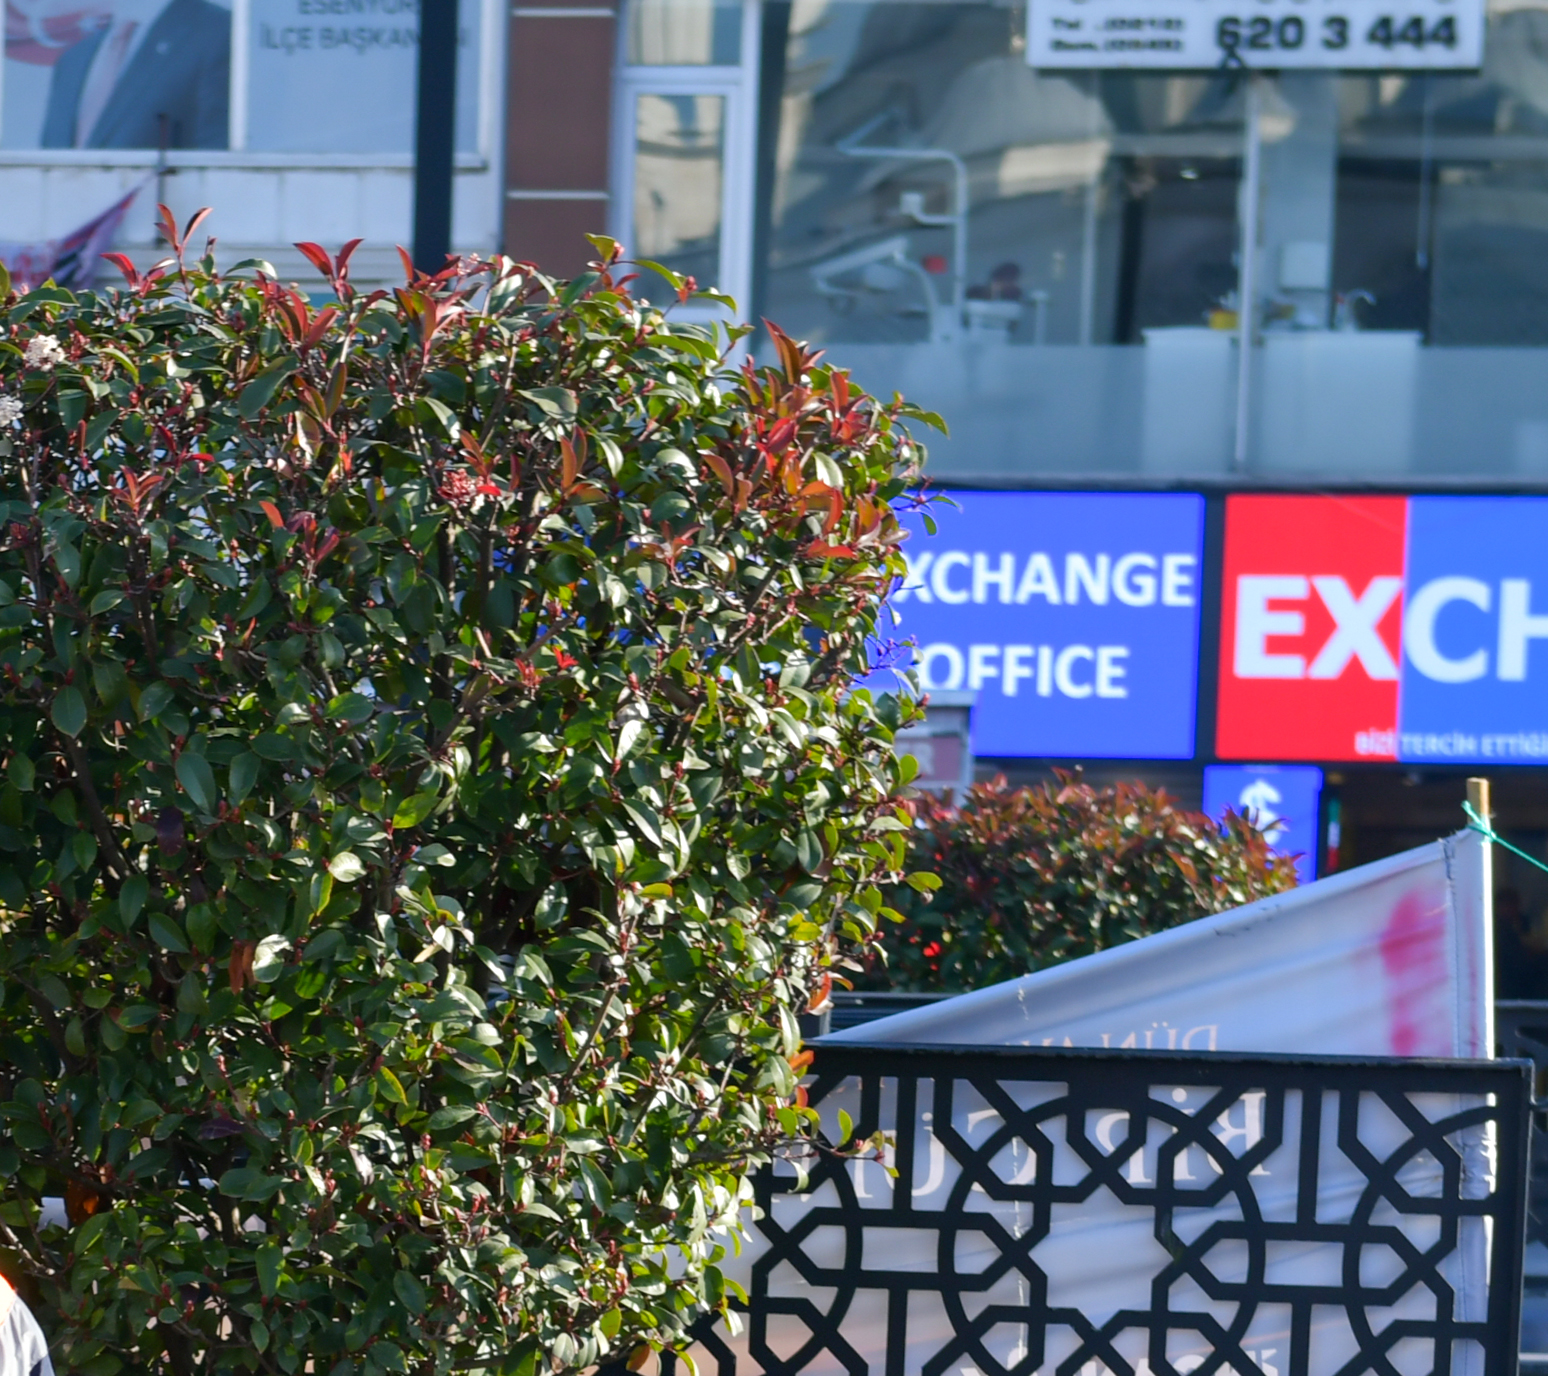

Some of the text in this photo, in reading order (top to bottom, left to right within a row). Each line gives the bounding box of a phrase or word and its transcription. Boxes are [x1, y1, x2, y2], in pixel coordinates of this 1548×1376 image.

[1216, 16, 1304, 50] 620
[1321, 17, 1350, 50] 3
[1367, 15, 1458, 49] 444
[891, 551, 1197, 607] XCHANGE
[915, 643, 1130, 698] OFFICE
